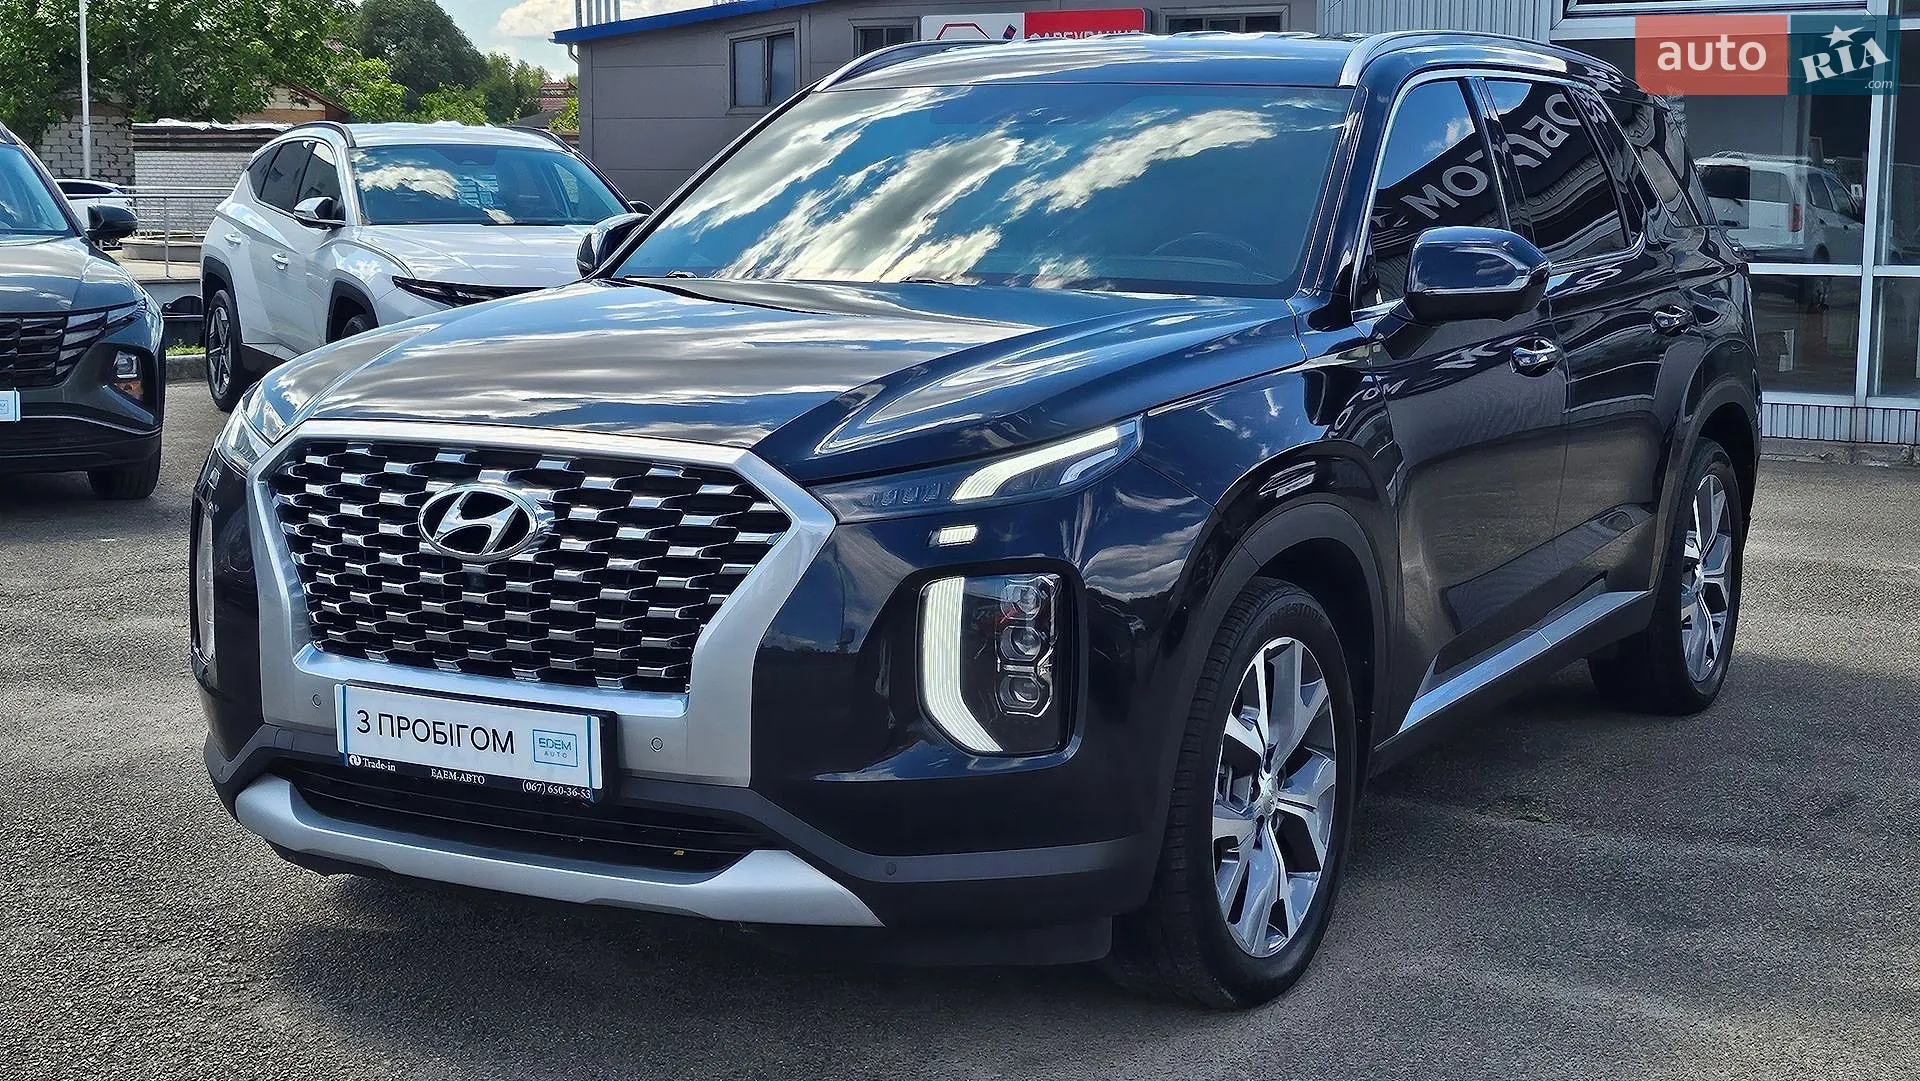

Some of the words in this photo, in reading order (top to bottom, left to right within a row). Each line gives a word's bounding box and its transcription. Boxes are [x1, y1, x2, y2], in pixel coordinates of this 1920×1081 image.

[356, 709, 371, 734] З
[378, 712, 515, 755] ПРОБІГОМ
[538, 737, 572, 751] EDEM
[544, 750, 568, 759] AUTO
[362, 757, 396, 772] Trade-in
[522, 779, 546, 795] (067)
[547, 786, 591, 799] 650-36-53
